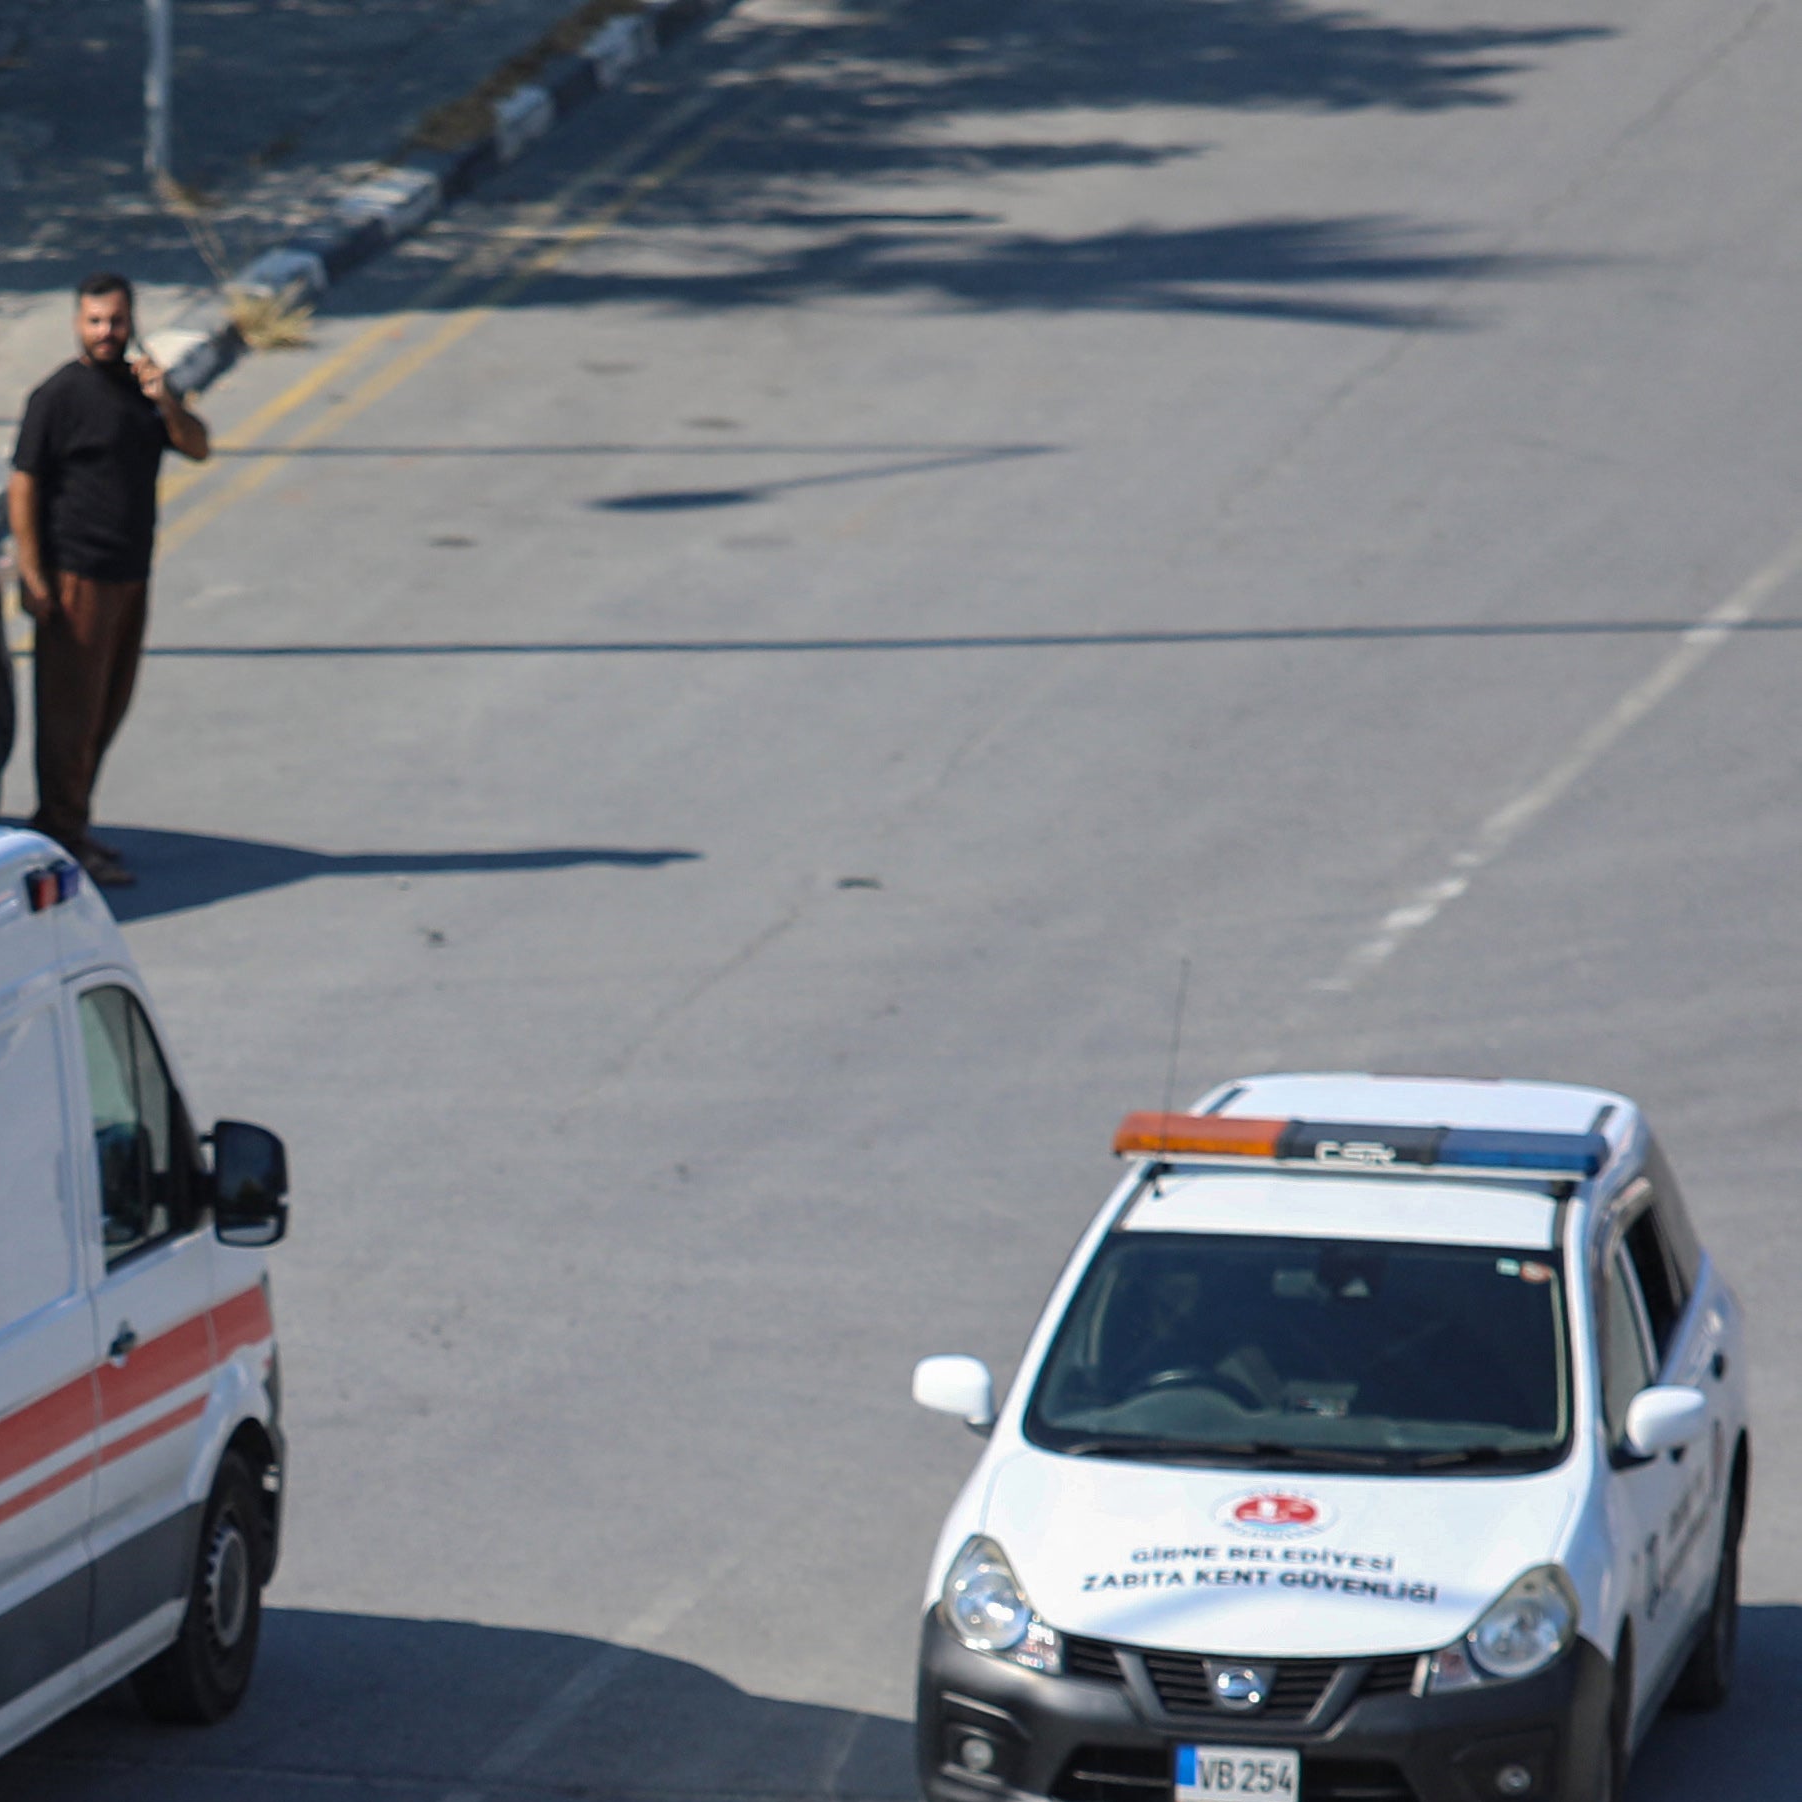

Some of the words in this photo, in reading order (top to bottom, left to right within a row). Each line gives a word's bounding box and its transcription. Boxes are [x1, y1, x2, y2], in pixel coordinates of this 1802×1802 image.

[1132, 1546, 1219, 1565] GİRNE
[1228, 1546, 1395, 1574] BELEDİYESİ
[1194, 1569, 1270, 1587] KENT
[1279, 1568, 1439, 1605] GÜVENLİĞİ
[1199, 1760, 1234, 1790] VB
[1240, 1761, 1291, 1792] 254
